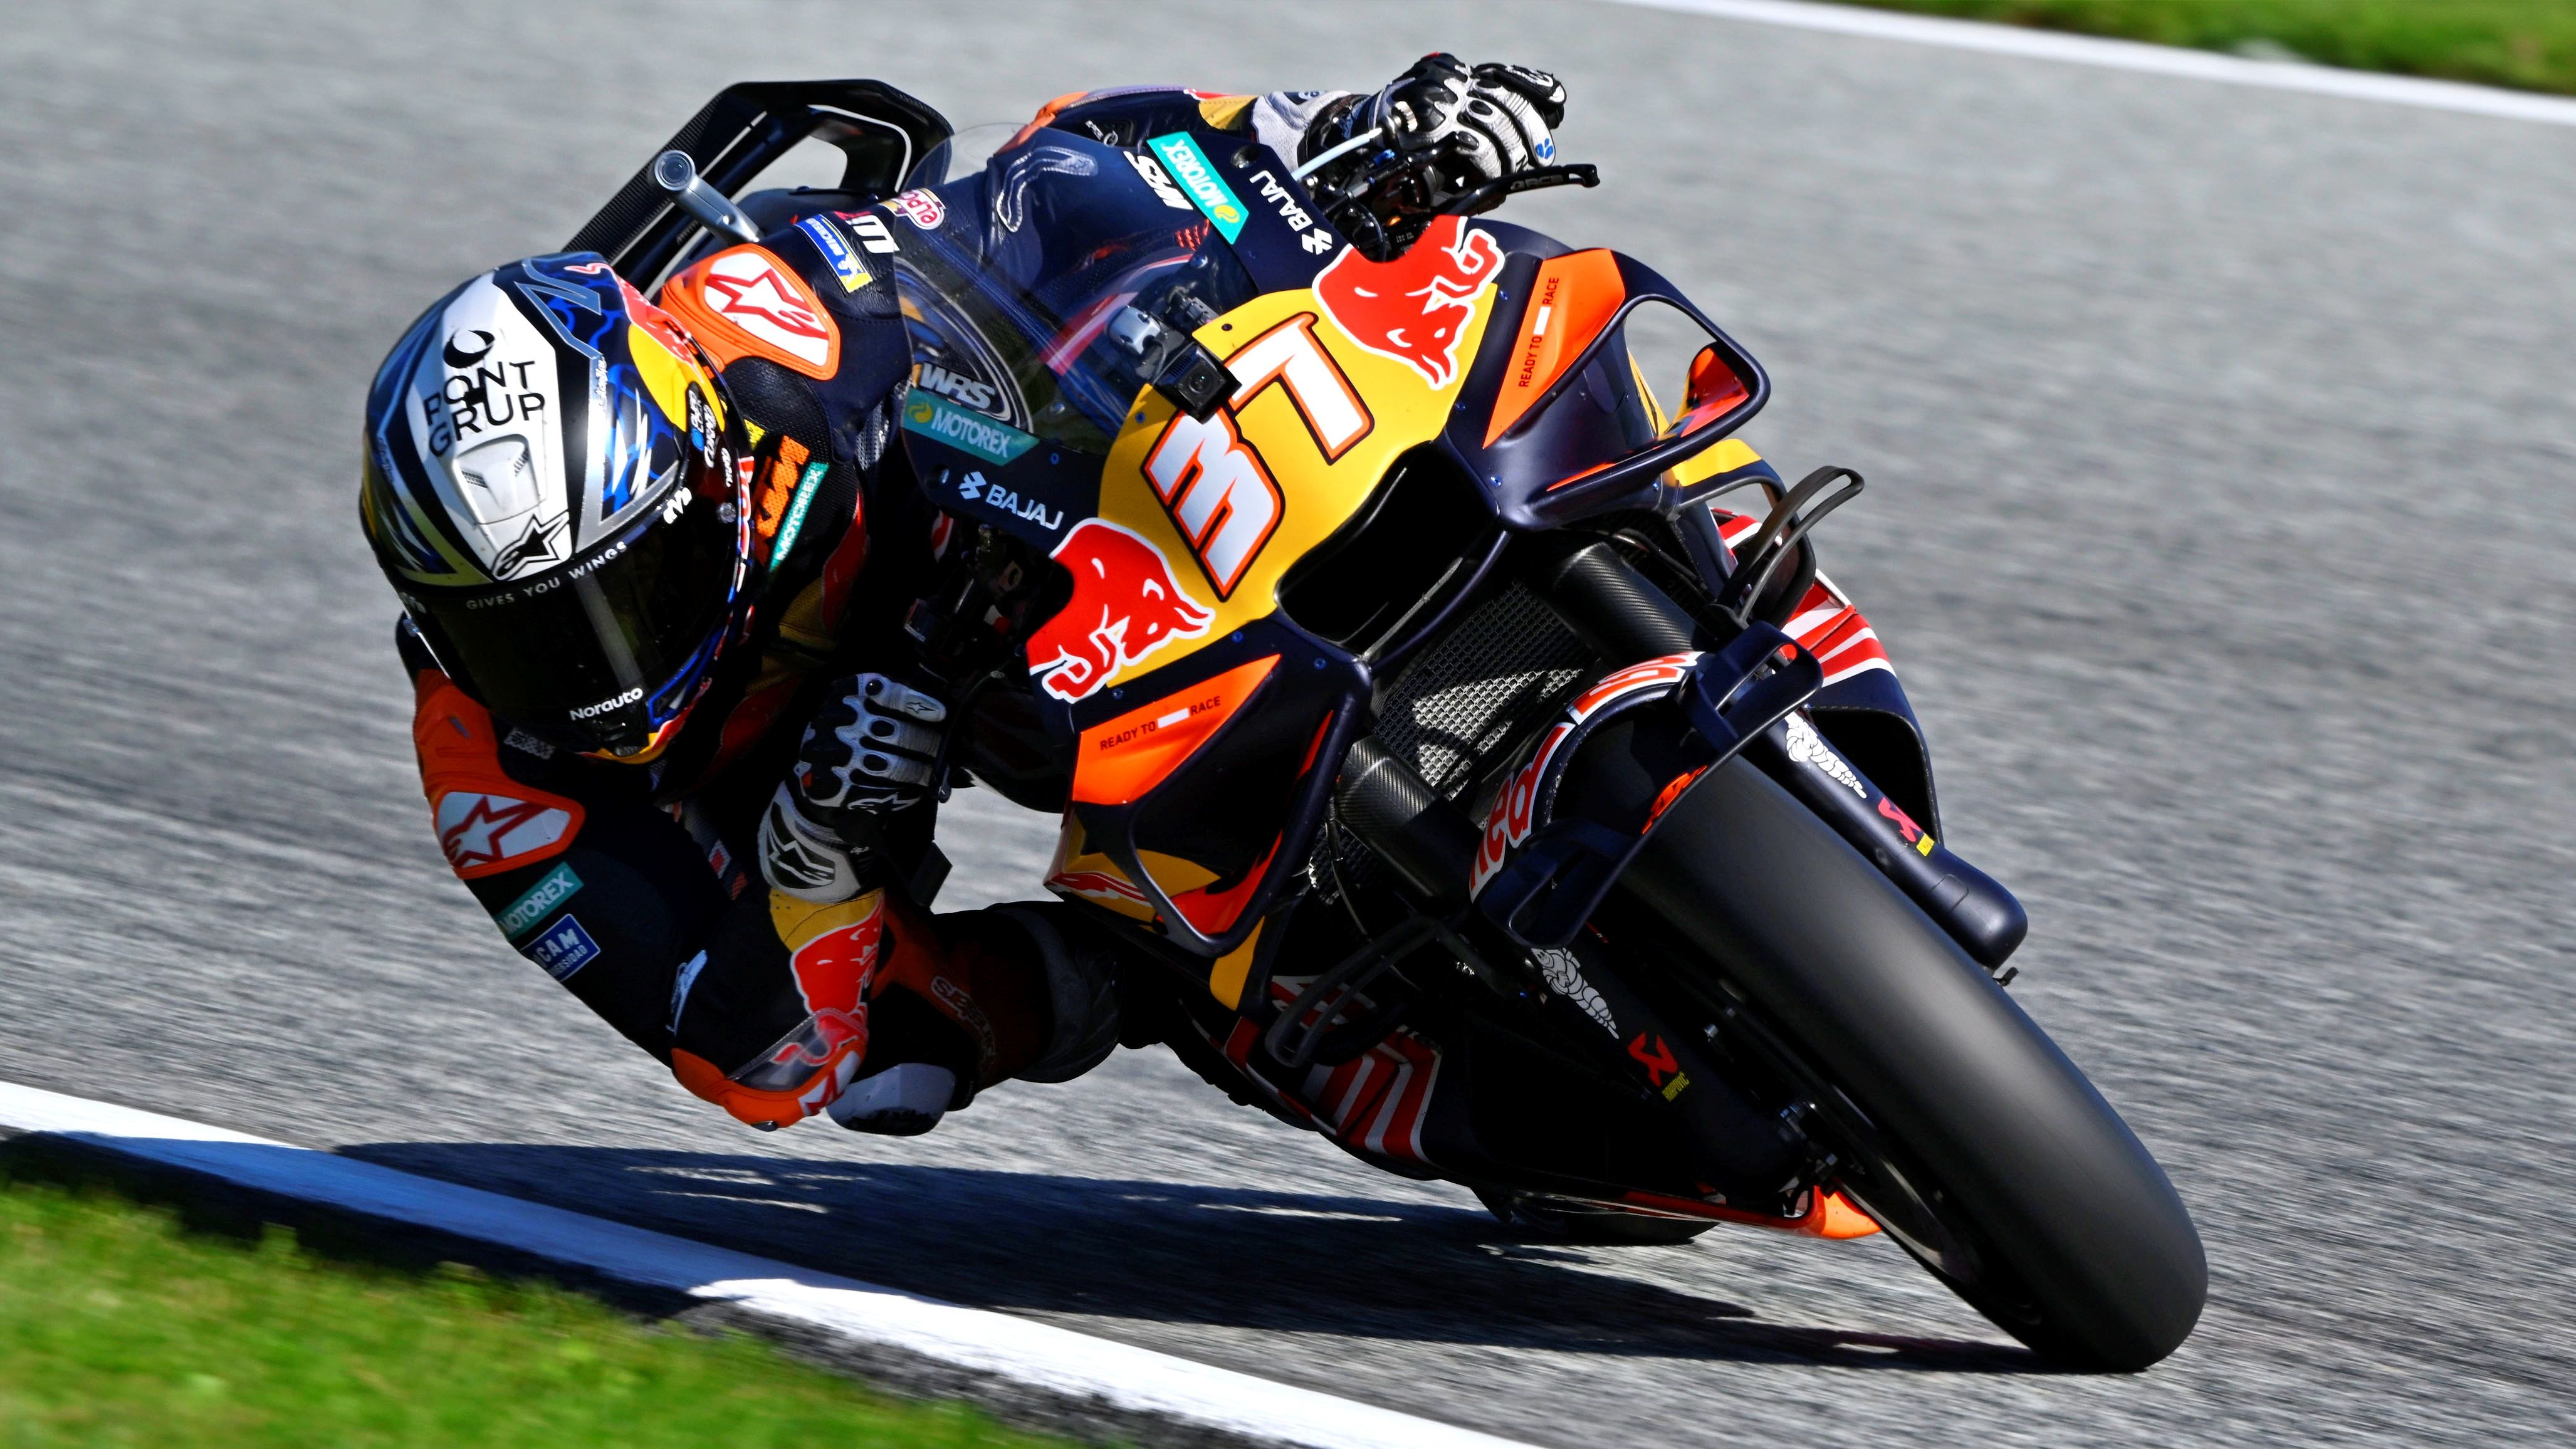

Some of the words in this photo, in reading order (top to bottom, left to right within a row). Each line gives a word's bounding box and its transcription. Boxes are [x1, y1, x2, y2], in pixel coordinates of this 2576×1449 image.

[1123, 150, 1193, 210] WRS
[1161, 139, 1222, 207] MOTOREX
[1249, 170, 1313, 232] BAJAJ
[1518, 352, 1537, 388] READY
[1529, 336, 1543, 350] TO
[1542, 277, 1559, 305] RACE
[424, 361, 535, 425] PONT
[920, 363, 996, 409] WRS
[429, 393, 545, 456] GRUP
[931, 409, 1011, 458] MOTOREX
[1141, 311, 1374, 602] 37
[775, 469, 820, 561] MOTOREX
[985, 484, 1064, 530] BAJAJ
[466, 593, 515, 610] GIVES
[523, 577, 561, 597] YOU
[568, 541, 627, 579] WINGS
[570, 686, 644, 719] Norauto
[1100, 728, 1139, 751] READY
[1141, 721, 1156, 736] TO
[1190, 695, 1222, 716] RACE
[505, 872, 574, 934] MOTOREX
